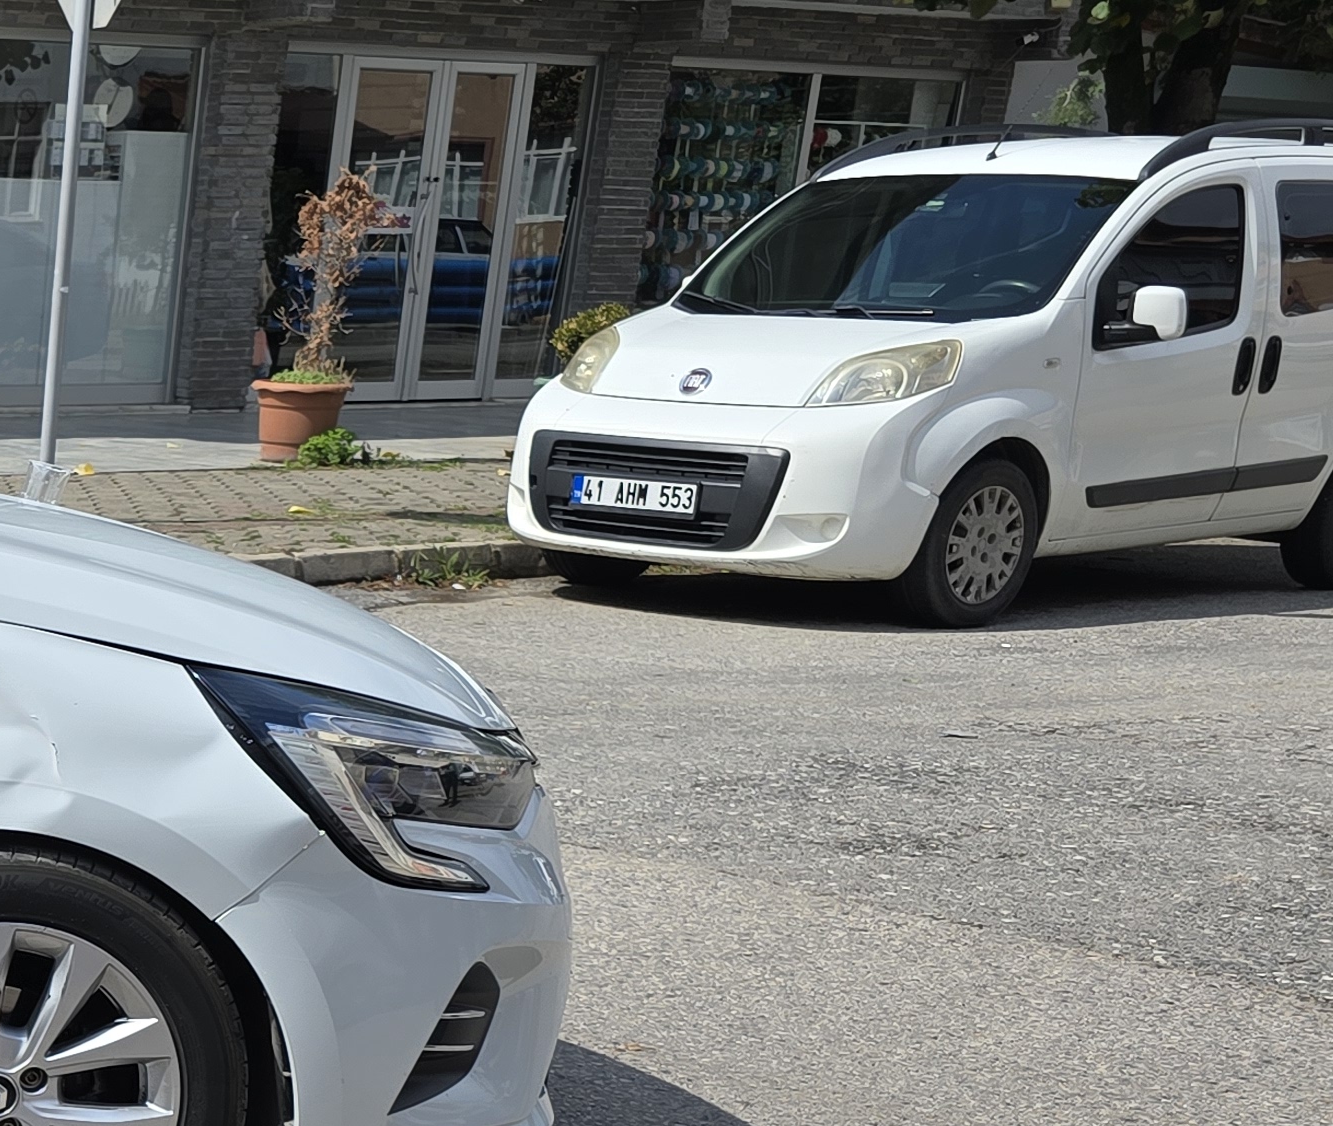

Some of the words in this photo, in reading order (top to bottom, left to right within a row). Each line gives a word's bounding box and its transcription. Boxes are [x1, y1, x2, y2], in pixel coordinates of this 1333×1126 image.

[583, 479, 604, 502] 41
[614, 481, 649, 507] AHM
[658, 485, 695, 510] 553
